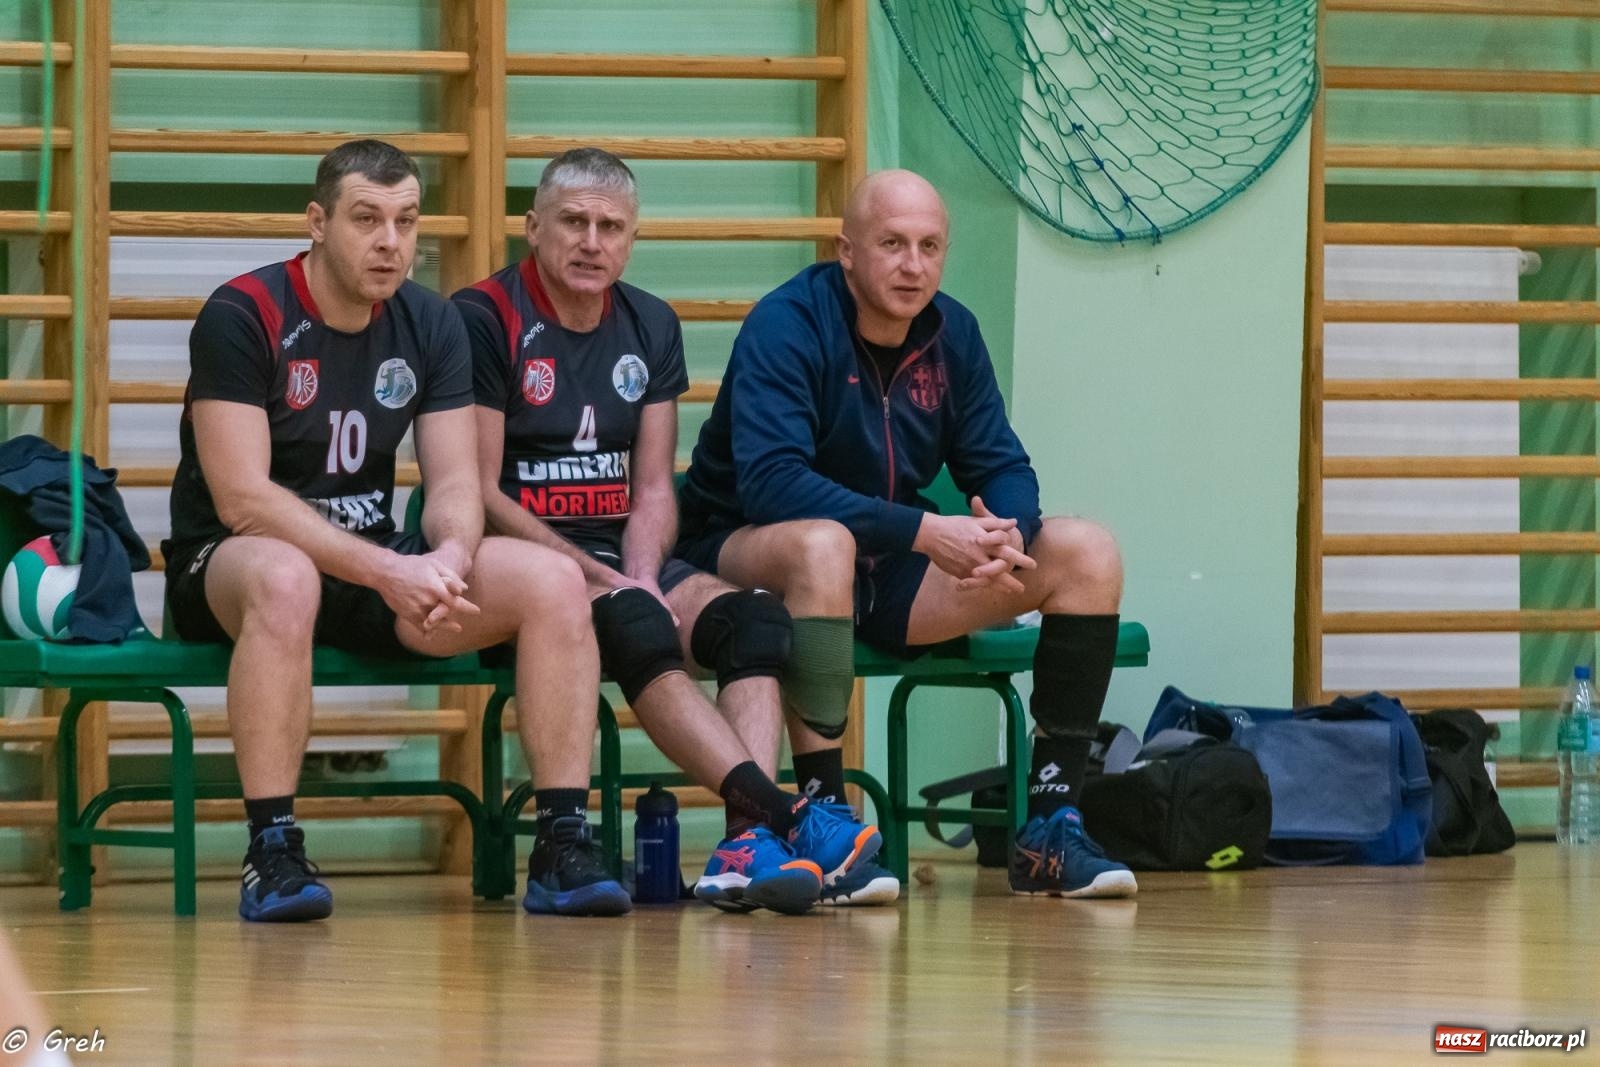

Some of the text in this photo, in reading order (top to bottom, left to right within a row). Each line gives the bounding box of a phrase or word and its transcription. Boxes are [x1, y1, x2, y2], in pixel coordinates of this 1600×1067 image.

[327, 409, 368, 474] 10
[573, 405, 598, 452] 4
[520, 484, 629, 516] NORTHER
[1029, 783, 1070, 795] OTTO
